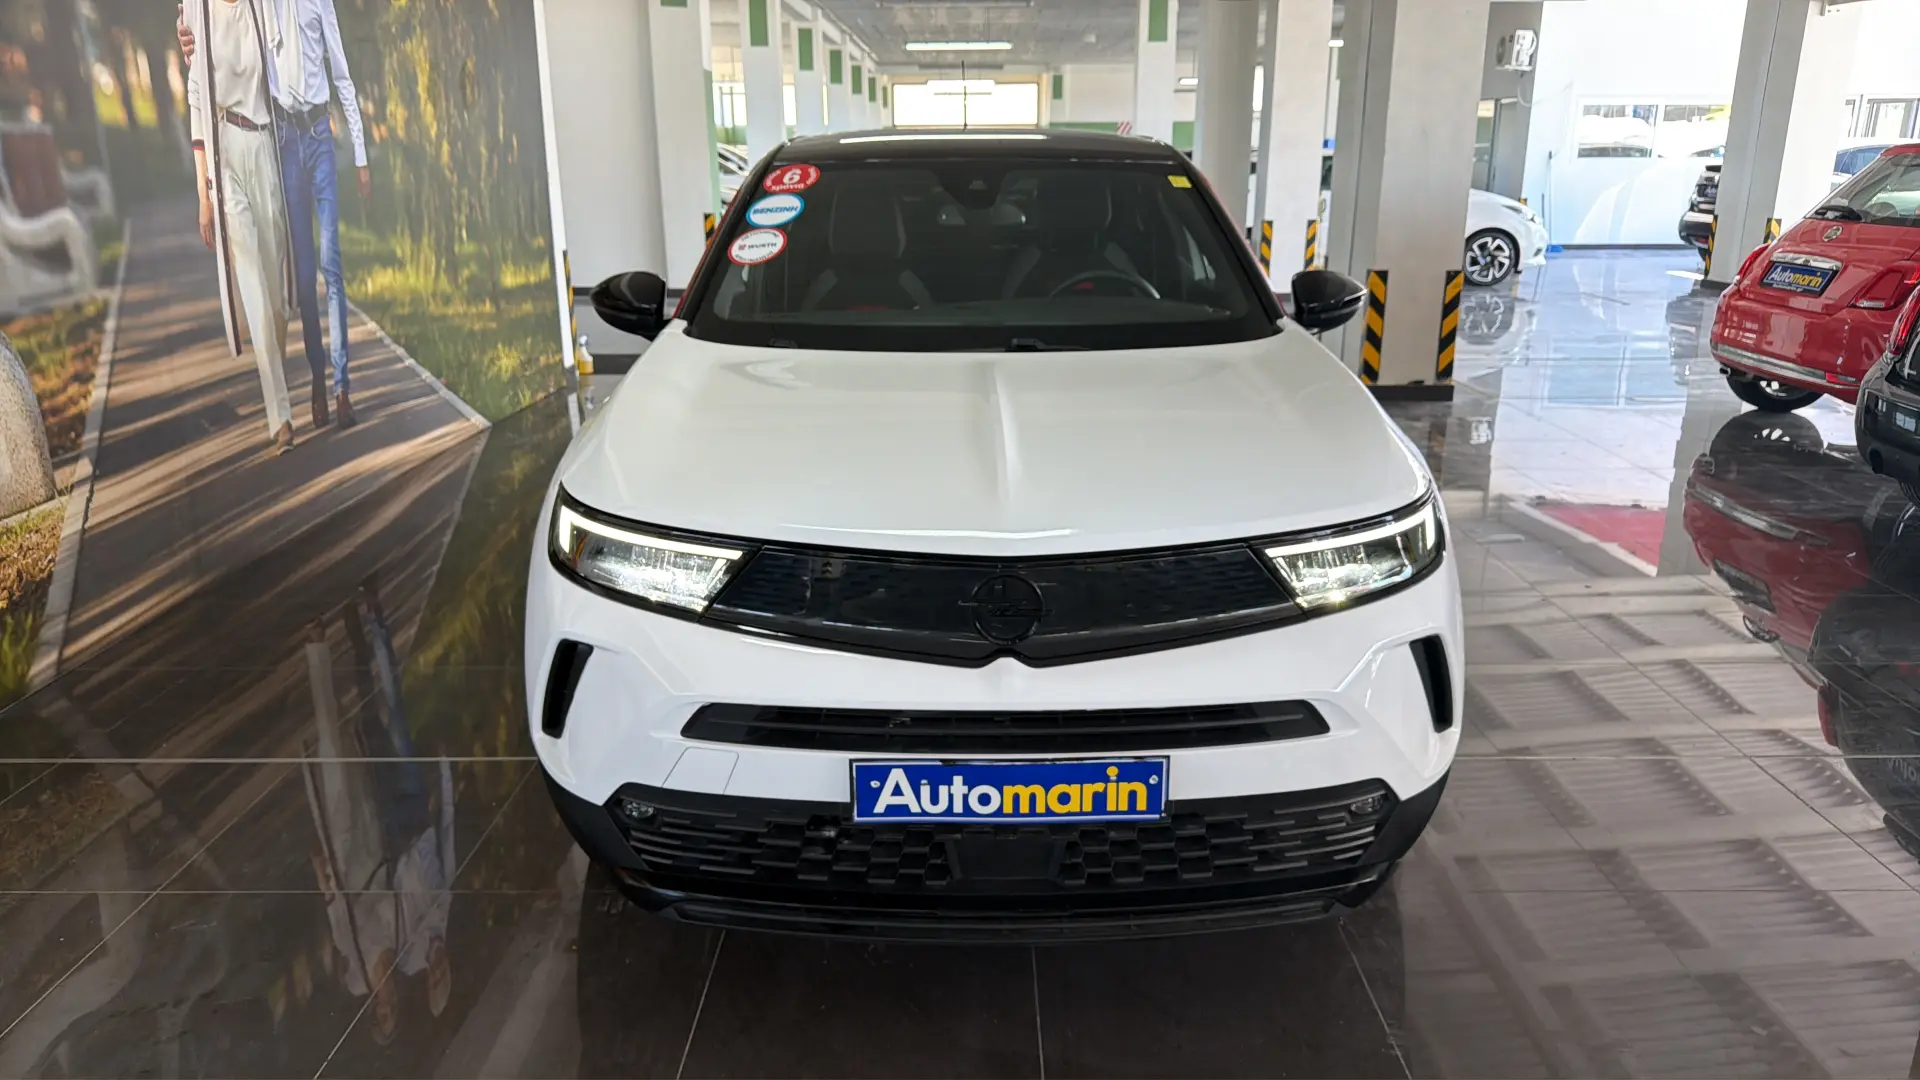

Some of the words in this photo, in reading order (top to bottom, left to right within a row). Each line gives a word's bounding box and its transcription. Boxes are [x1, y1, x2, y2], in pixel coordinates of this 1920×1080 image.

[782, 168, 802, 185] 6
[1768, 265, 1823, 288] Automarin
[872, 766, 1148, 815] Automarin
